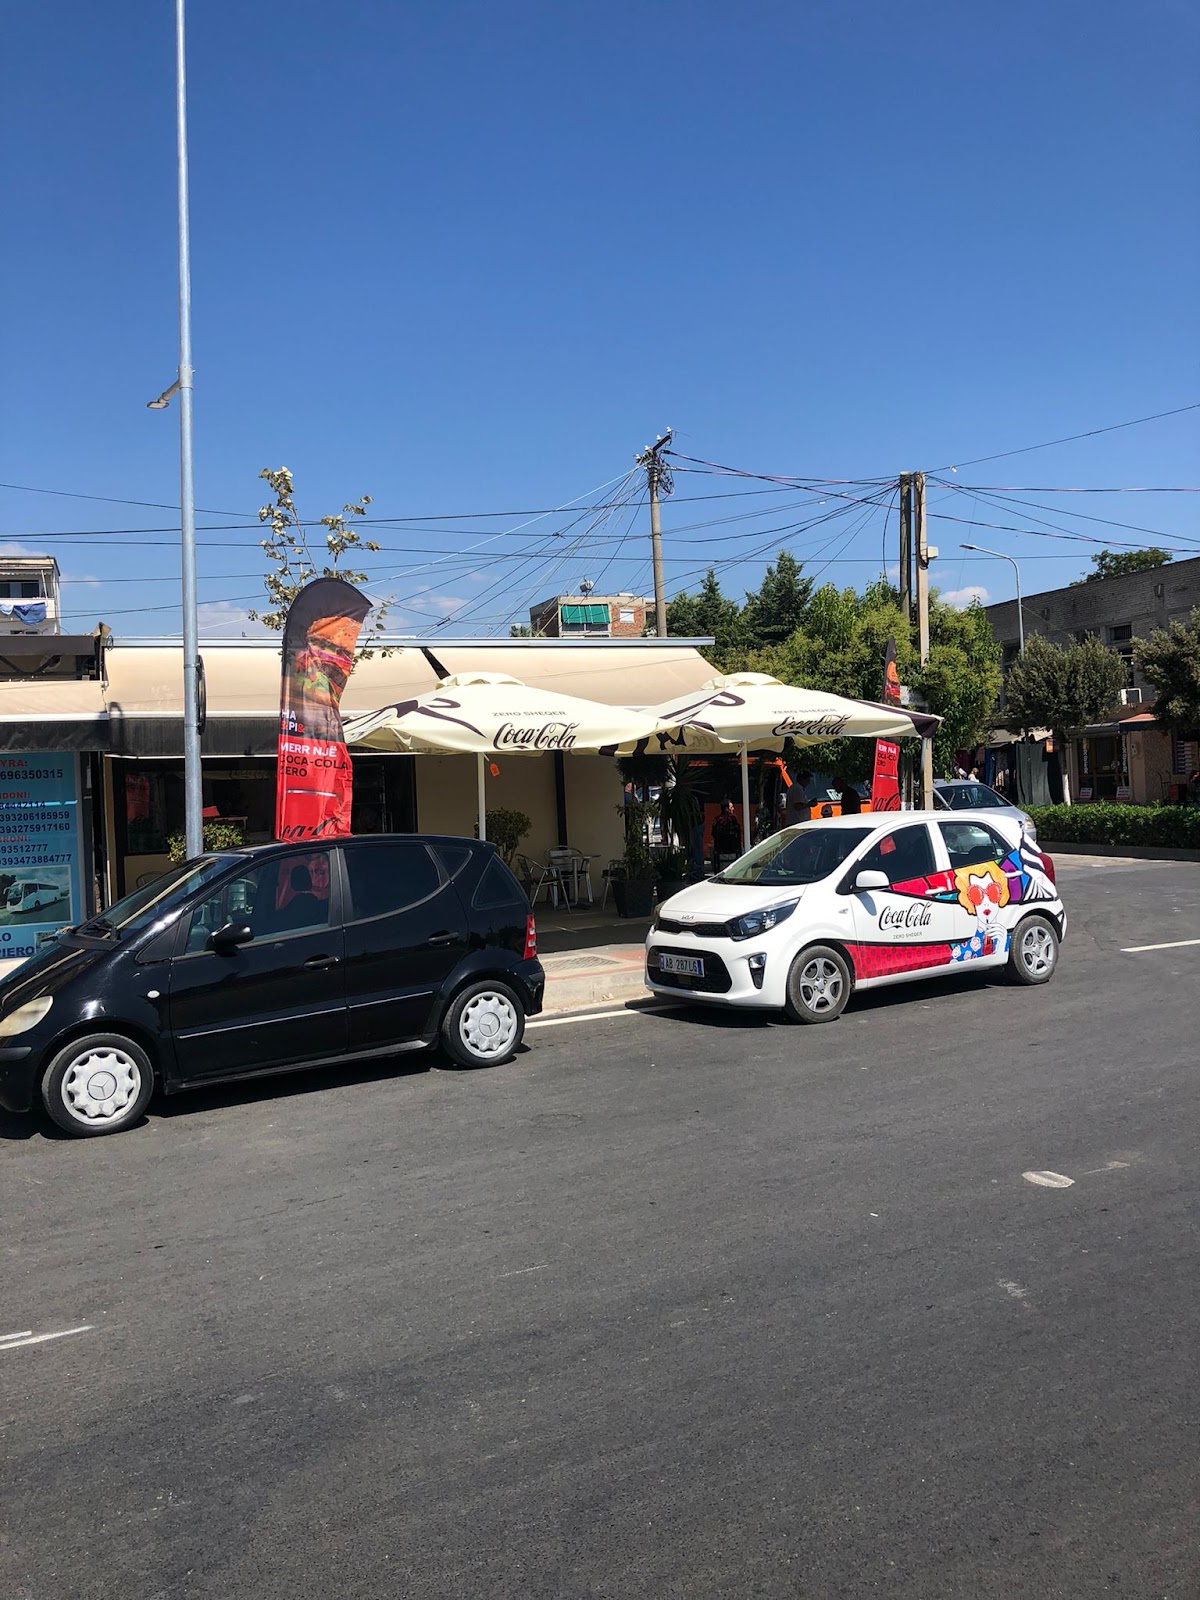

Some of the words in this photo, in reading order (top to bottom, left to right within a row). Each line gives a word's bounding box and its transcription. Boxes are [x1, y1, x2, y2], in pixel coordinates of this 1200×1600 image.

[772, 714, 853, 737] Coca-Cola
[492, 722, 581, 751] Coca-Cola
[313, 744, 337, 758] NJË
[0, 769, 63, 781] 696350315
[0, 844, 49, 854] 93512777
[0, 854, 72, 866] 393473884777
[878, 901, 933, 931] Coca-Cola
